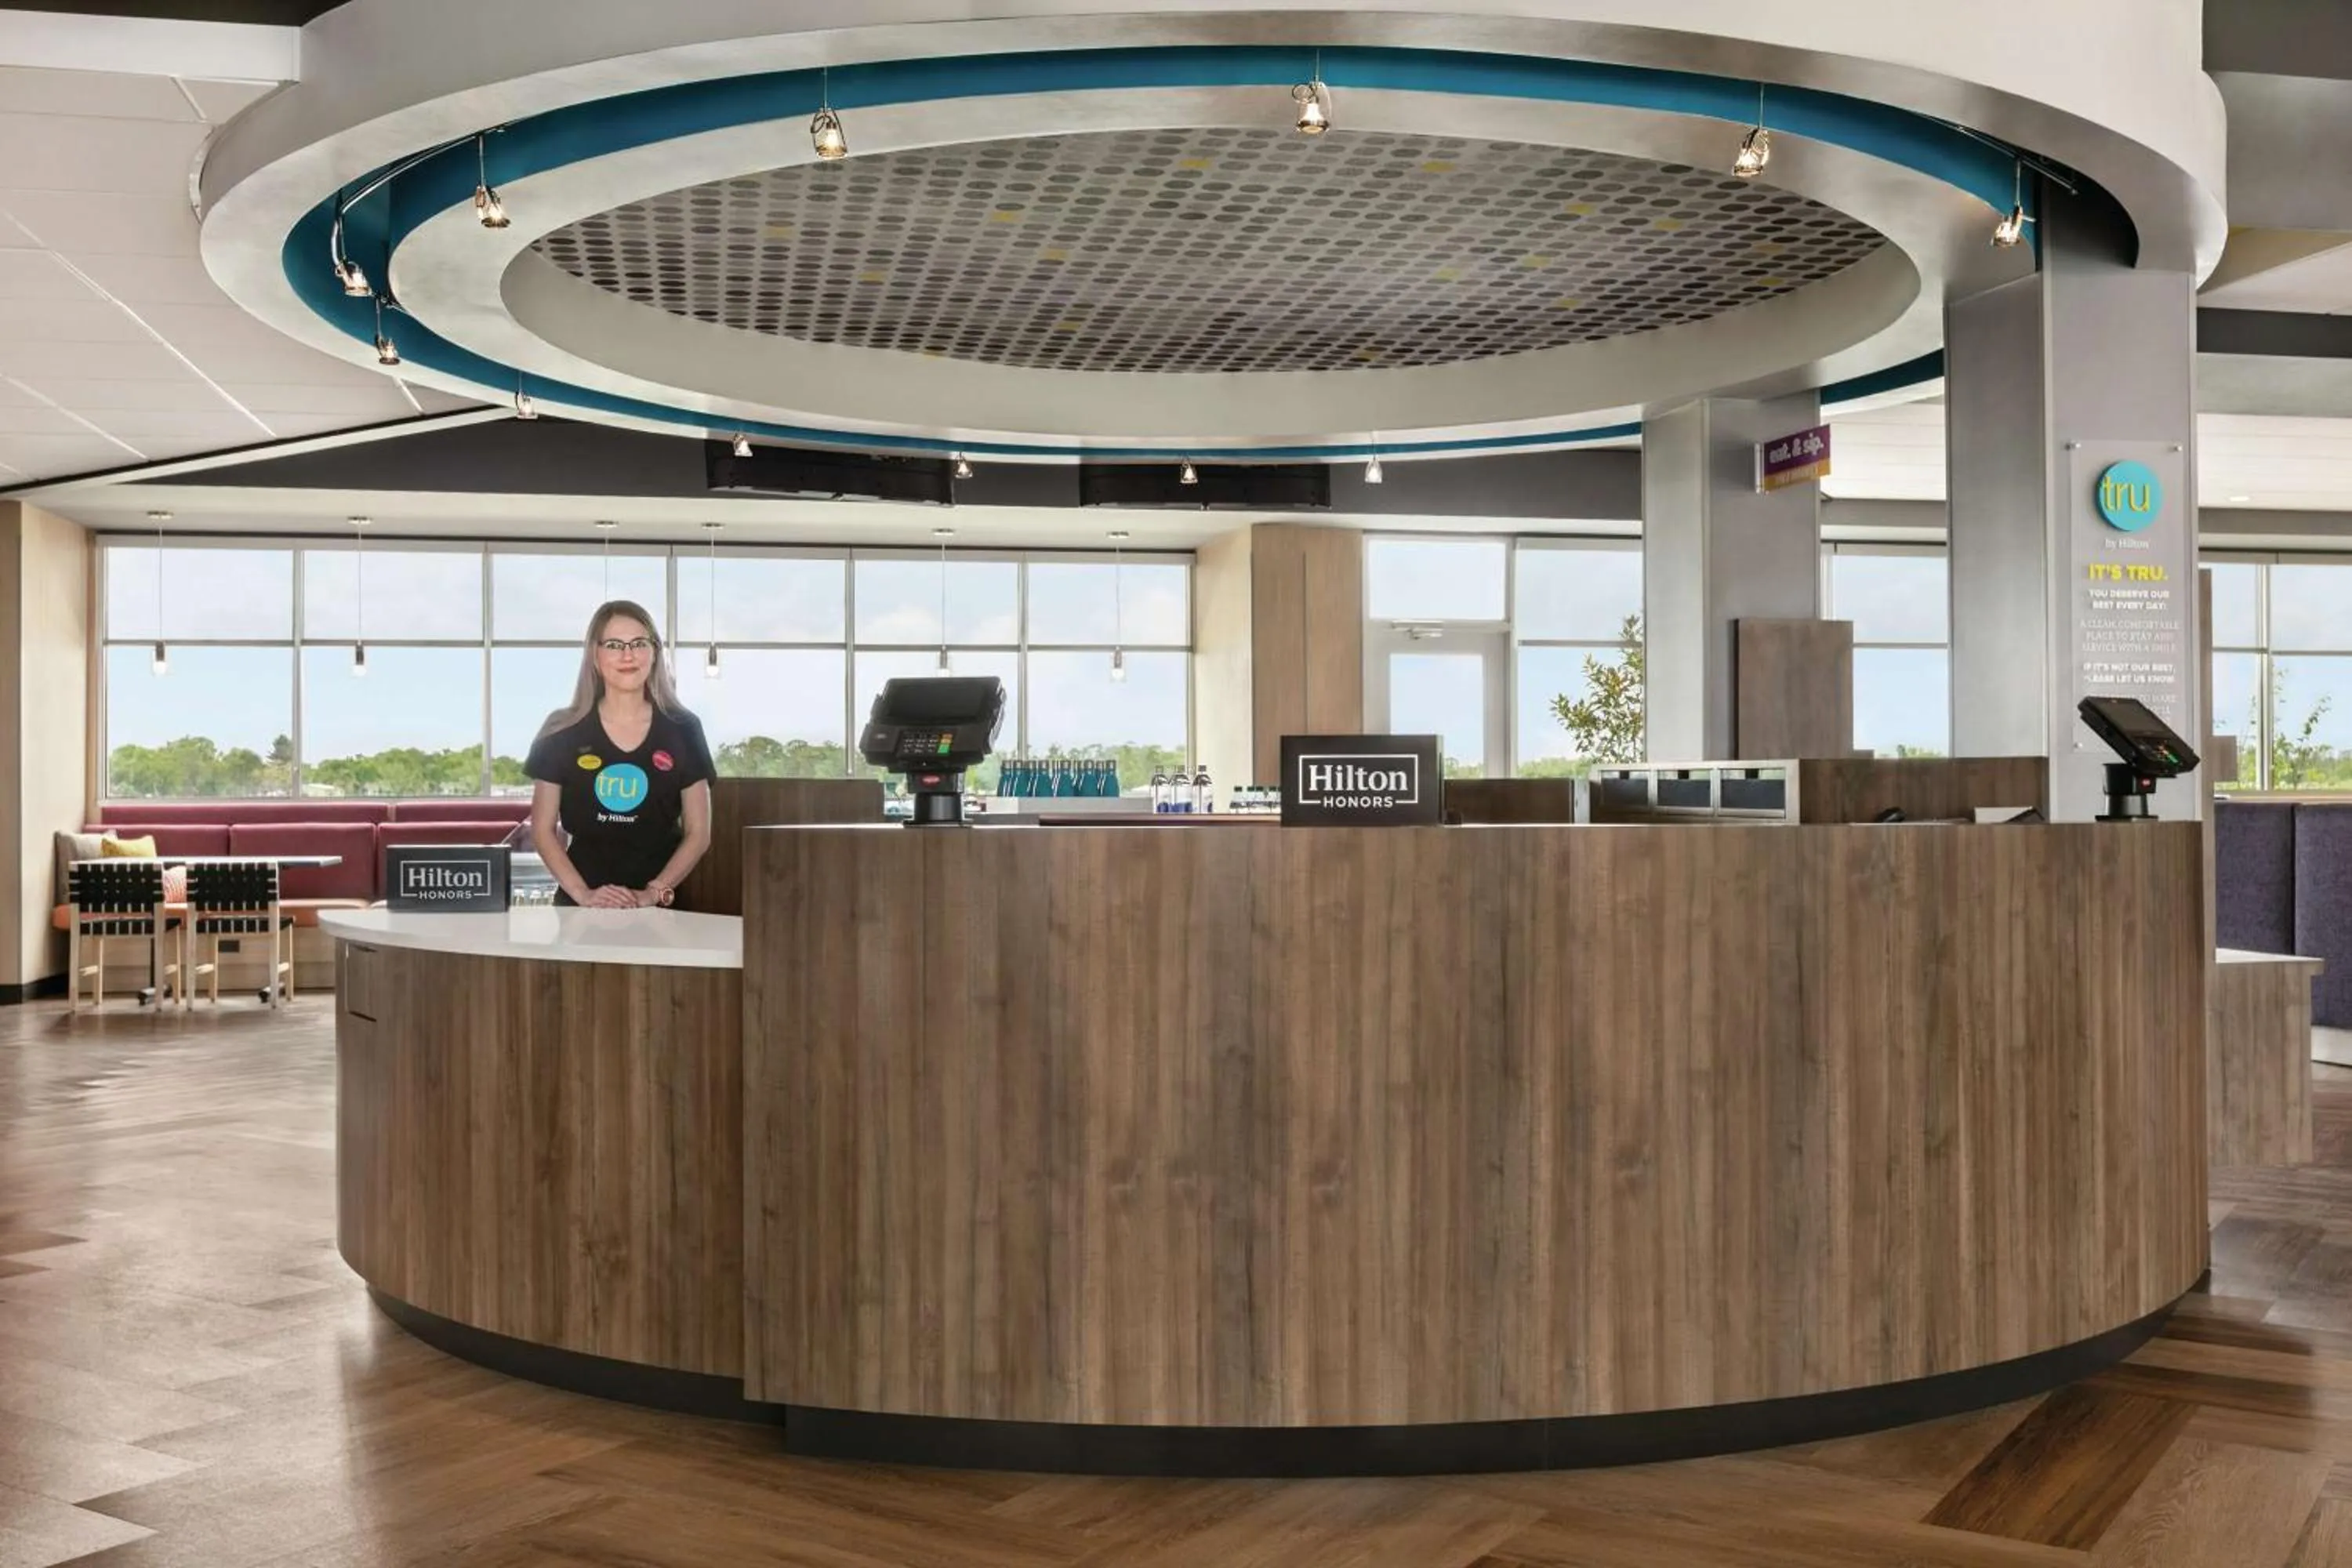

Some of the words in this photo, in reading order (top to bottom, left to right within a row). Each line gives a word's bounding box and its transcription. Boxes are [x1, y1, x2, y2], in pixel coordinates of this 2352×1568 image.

[2103, 476, 2151, 512] tru
[2105, 539, 2116, 551] by
[2118, 539, 2150, 549] Hilton
[2089, 563, 2122, 580] IT'S
[2126, 564, 2169, 581] TRU.
[2089, 589, 2108, 598] YOU
[2110, 589, 2148, 598] DESERVE
[2150, 590, 2170, 598] OUR
[2092, 600, 2114, 609] BEST
[2116, 601, 2144, 609] EVERY
[2083, 662, 2092, 671] IF
[2092, 662, 2110, 672] IT'S
[2111, 663, 2130, 672] NOT
[2131, 663, 2150, 672] OUR
[2116, 673, 2132, 683] LET
[2133, 674, 2146, 683] US
[1308, 764, 1408, 791] Hilton
[597, 772, 637, 798] tru
[1323, 796, 1393, 808] HONORS
[597, 813, 608, 822] by
[408, 867, 483, 887] Hilton
[419, 890, 472, 899] HONORS
